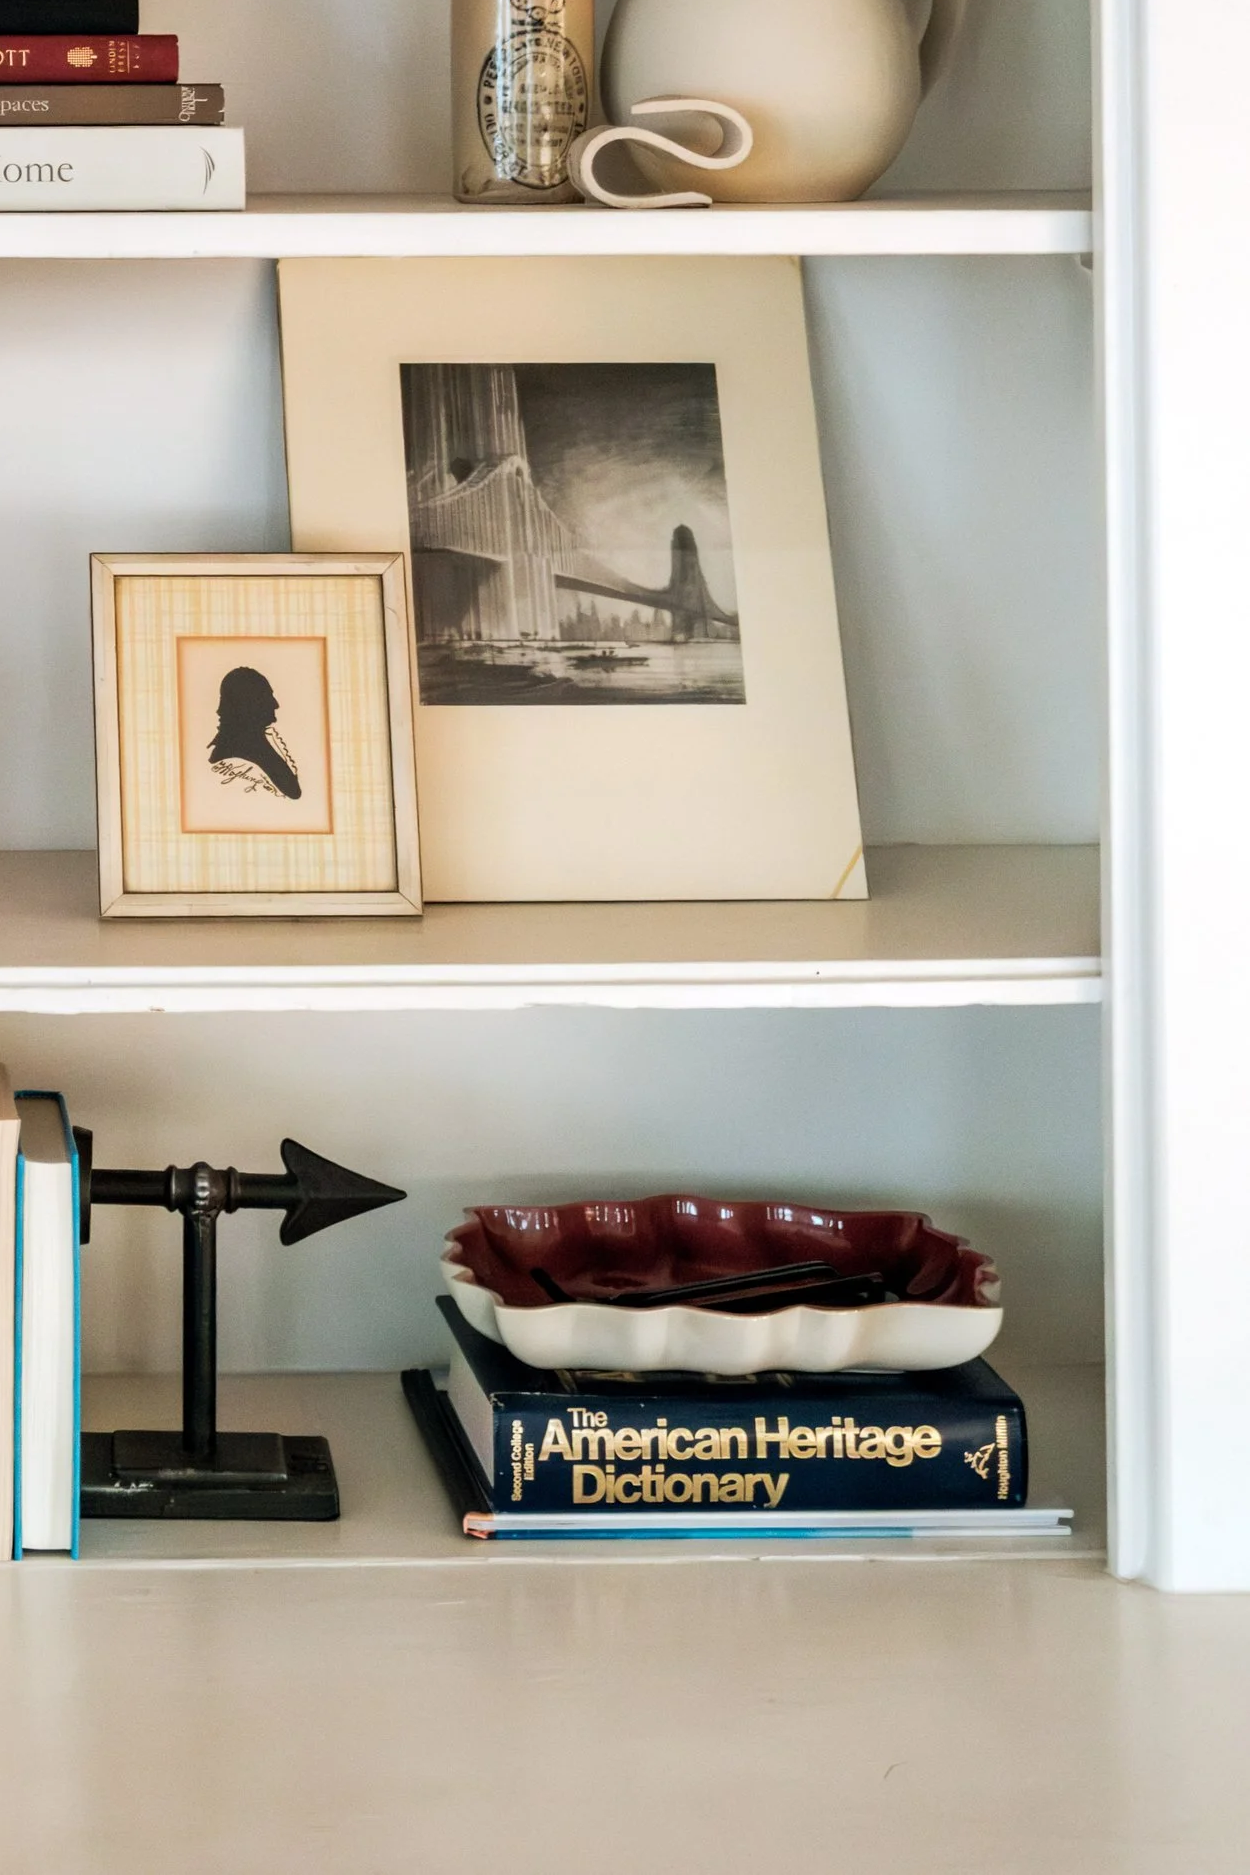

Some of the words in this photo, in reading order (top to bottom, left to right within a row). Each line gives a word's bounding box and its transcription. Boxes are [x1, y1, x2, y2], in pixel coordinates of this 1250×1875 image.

[567, 1407, 608, 1428] The
[510, 1419, 523, 1462] College
[524, 1443, 535, 1481] Edition
[538, 1416, 746, 1461] American
[755, 1416, 942, 1467] Heritage
[511, 1462, 522, 1502] Second
[572, 1464, 790, 1508] Dictionary
[997, 1450, 1011, 1500] Houghton
